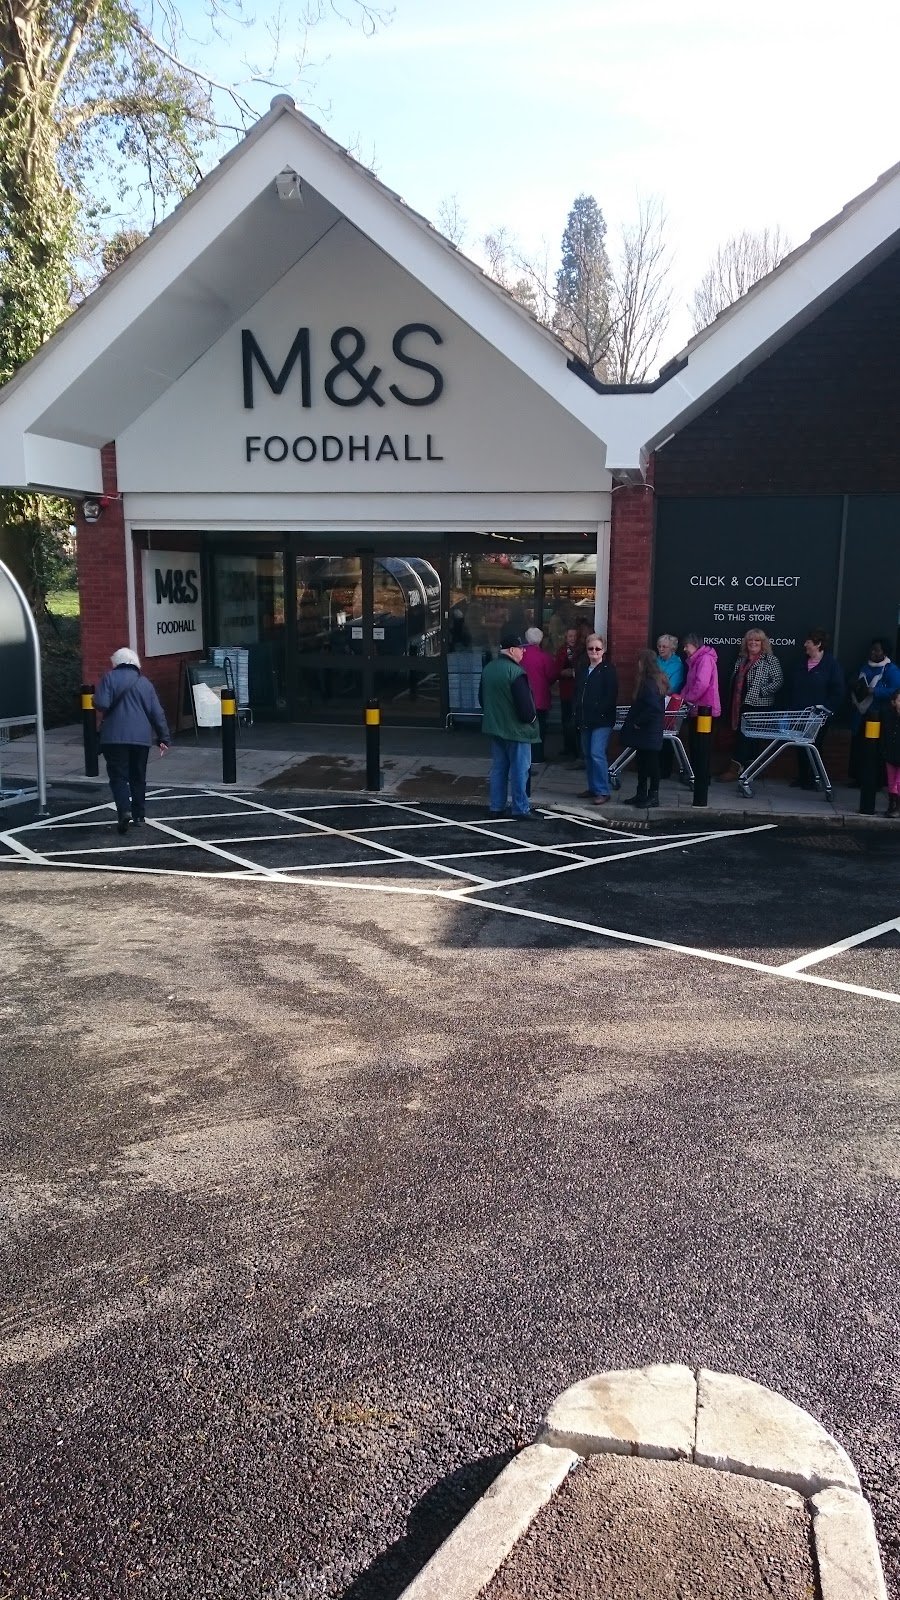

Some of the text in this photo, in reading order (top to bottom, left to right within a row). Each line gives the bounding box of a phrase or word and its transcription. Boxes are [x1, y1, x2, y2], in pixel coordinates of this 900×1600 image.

[241, 322, 445, 410] M&S
[246, 433, 444, 462] FOODHALL
[155, 568, 199, 605] M&S
[690, 575, 801, 587] CLICK & COLLECT
[713, 603, 776, 612] FREE DELIVERY
[713, 613, 776, 622] TO THIS STORE
[156, 620, 197, 635] FOODHALL
